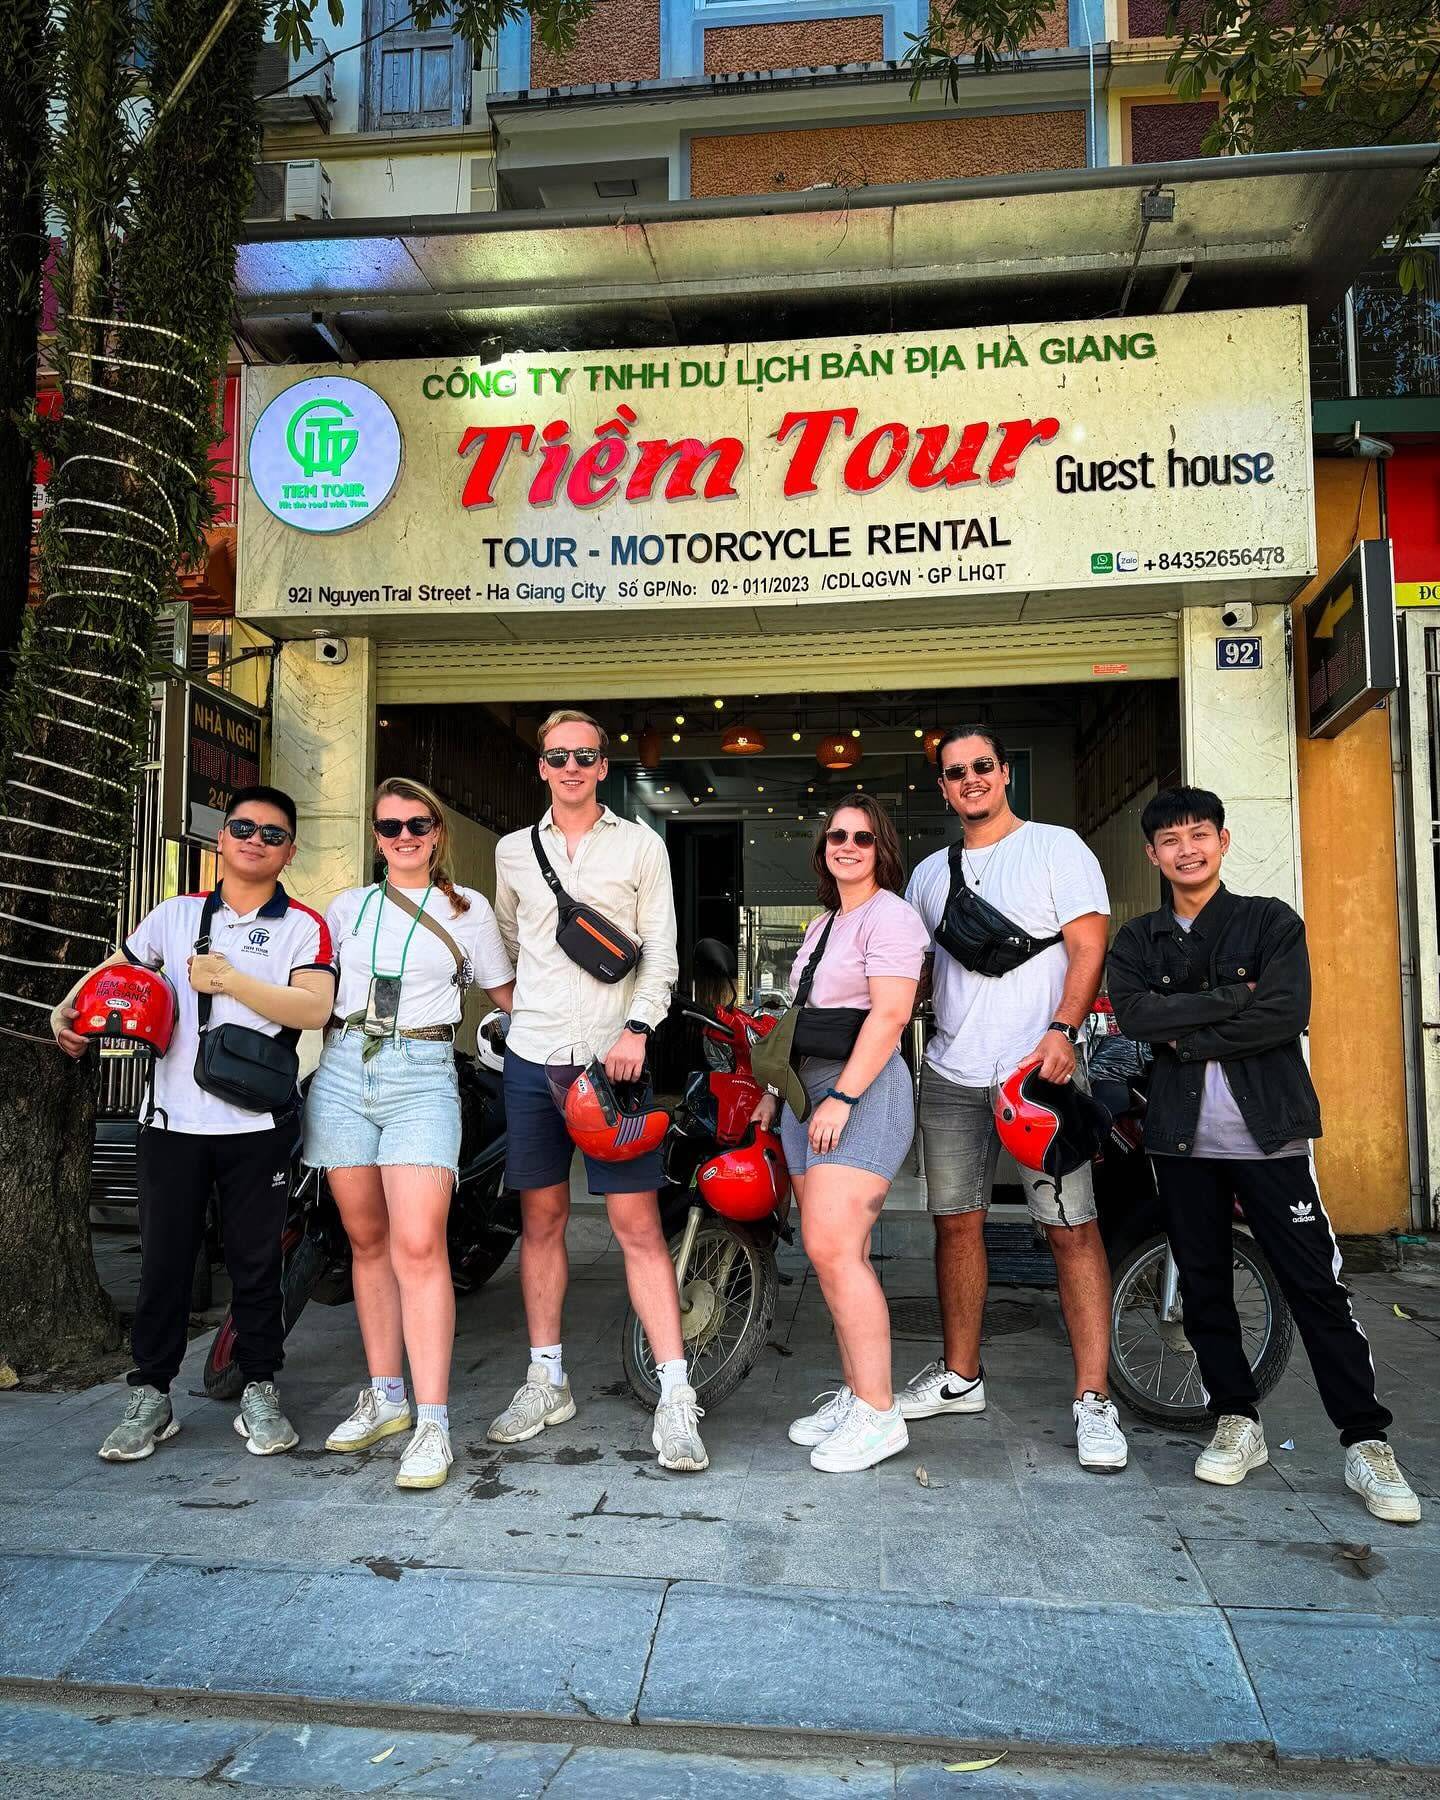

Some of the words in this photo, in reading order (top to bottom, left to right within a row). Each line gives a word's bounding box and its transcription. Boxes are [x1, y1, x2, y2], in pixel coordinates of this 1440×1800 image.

[422, 366, 517, 400] CÔNG
[527, 367, 573, 396] TY
[584, 362, 670, 392] TNHH
[681, 360, 726, 388] DU
[737, 354, 810, 392] LỊCH
[821, 343, 894, 380] BẢN
[904, 344, 966, 379] ĐỊA
[977, 334, 1029, 370] HÀ
[1040, 332, 1156, 365] GIANG
[457, 403, 745, 510] Tiềm
[776, 407, 1060, 499] Tour
[1056, 451, 1156, 494] Guest
[1167, 448, 1275, 488] house
[282, 484, 318, 499] TIEM
[321, 483, 366, 498] TOUR
[482, 537, 578, 568] TOUR
[611, 526, 851, 566] MOTORCYCLE
[867, 516, 1012, 556] RENTAL
[1120, 556, 1138, 565] Zalo
[1144, 546, 1285, 571] +84352656478
[318, 586, 379, 607] Nguyen
[381, 585, 412, 601] Trai
[418, 584, 471, 601] Street
[487, 583, 510, 600] Ha
[515, 582, 565, 603] Giang
[571, 582, 606, 603] City
[618, 578, 639, 598] Số
[643, 580, 697, 598] GP/No:
[711, 579, 729, 595] 02
[743, 576, 809, 594] 011/2023
[821, 569, 911, 590] /CDLQGVN
[928, 566, 952, 584] GP
[958, 563, 1007, 583] LHQT
[194, 703, 223, 738] NHÀ
[226, 718, 257, 753] NGHỈ
[208, 787, 233, 812] 24/
[112, 989, 148, 1005] GIANG
[1292, 1215, 1316, 1223] adidas
